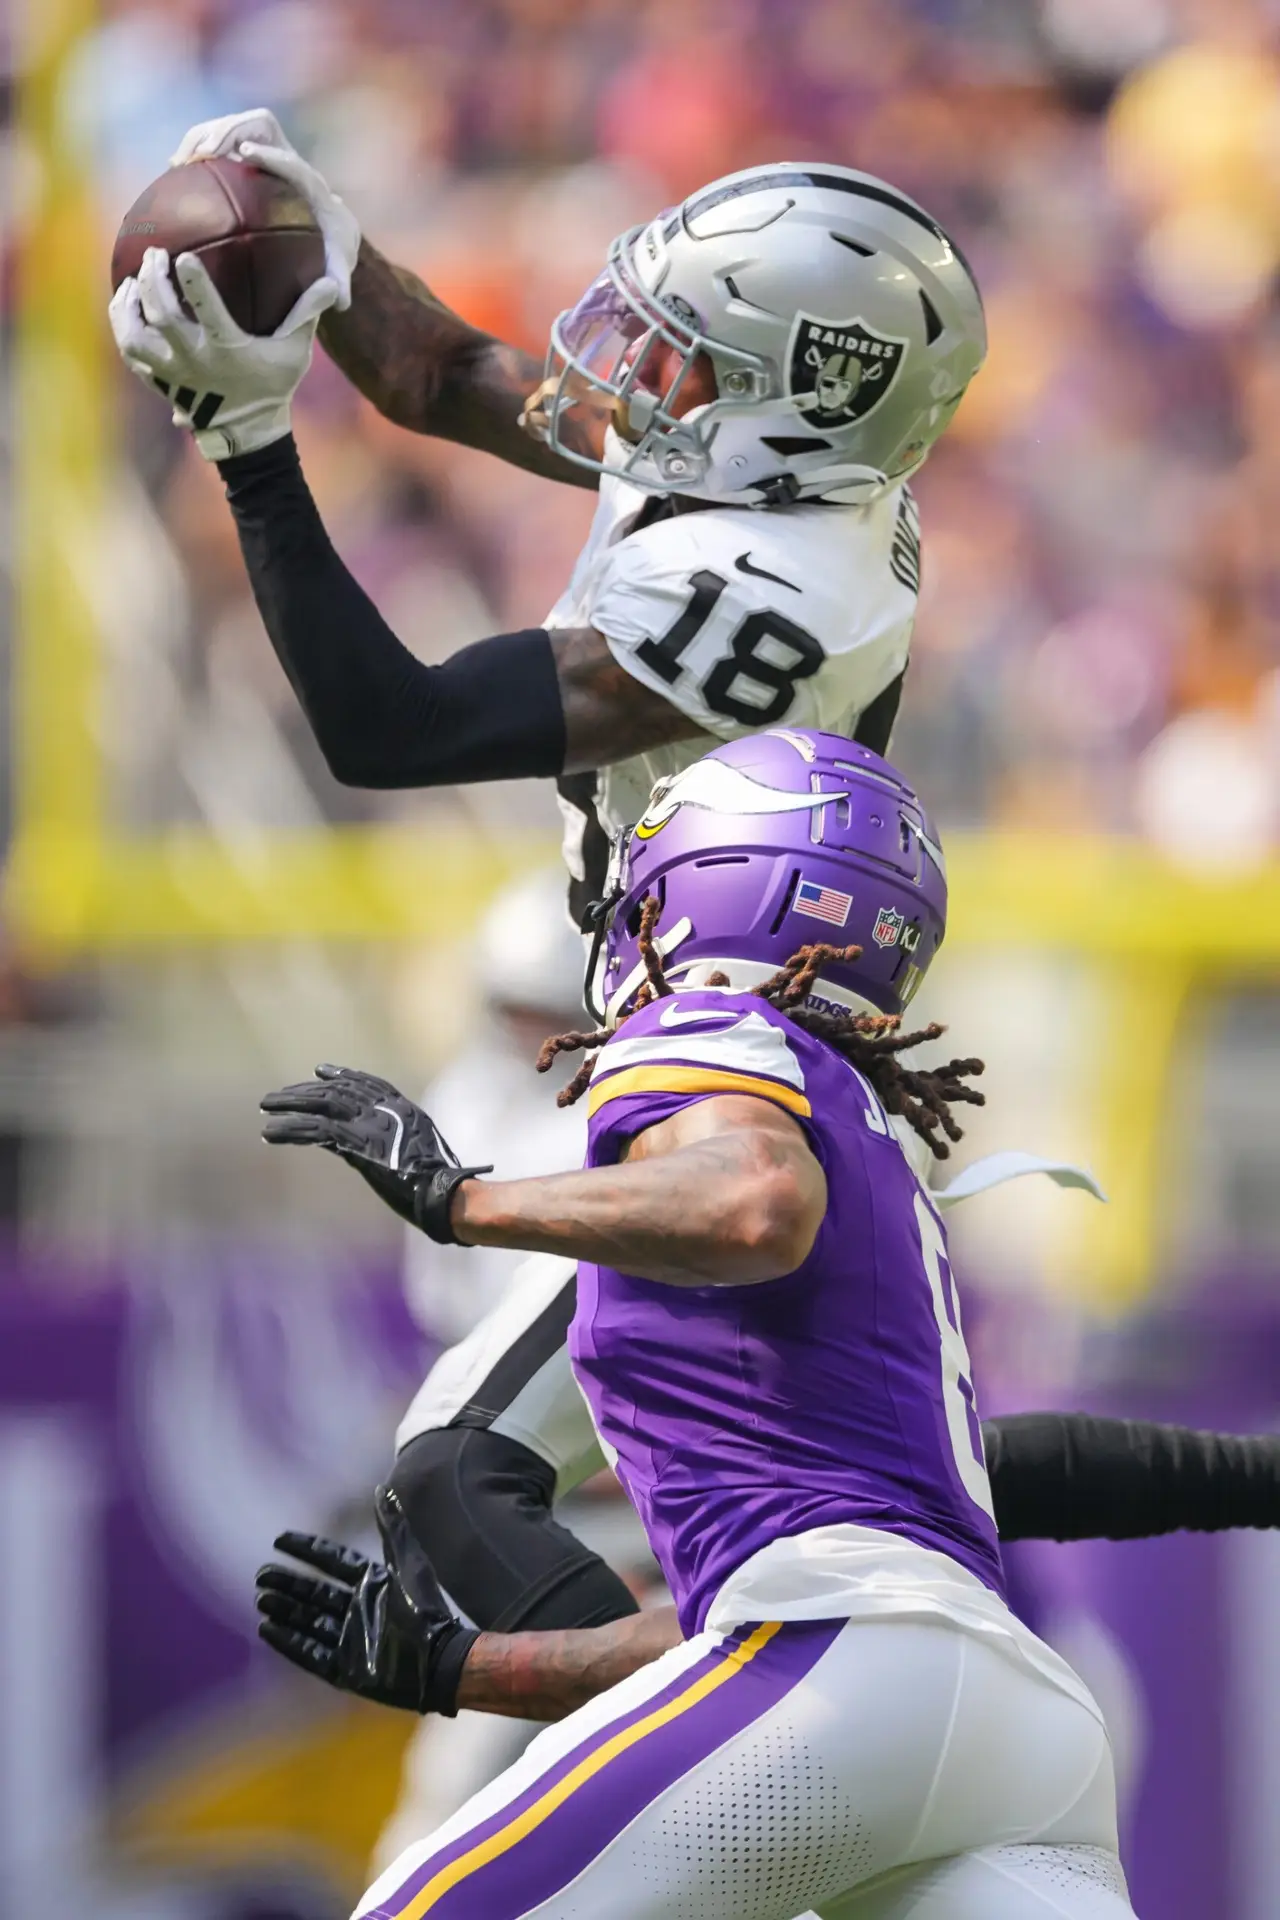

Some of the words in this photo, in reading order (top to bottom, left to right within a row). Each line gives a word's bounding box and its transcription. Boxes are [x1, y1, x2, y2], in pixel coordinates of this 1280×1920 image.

[808, 326, 895, 358] RAIDERS
[634, 569, 826, 727] 18
[877, 923, 898, 943] NFL
